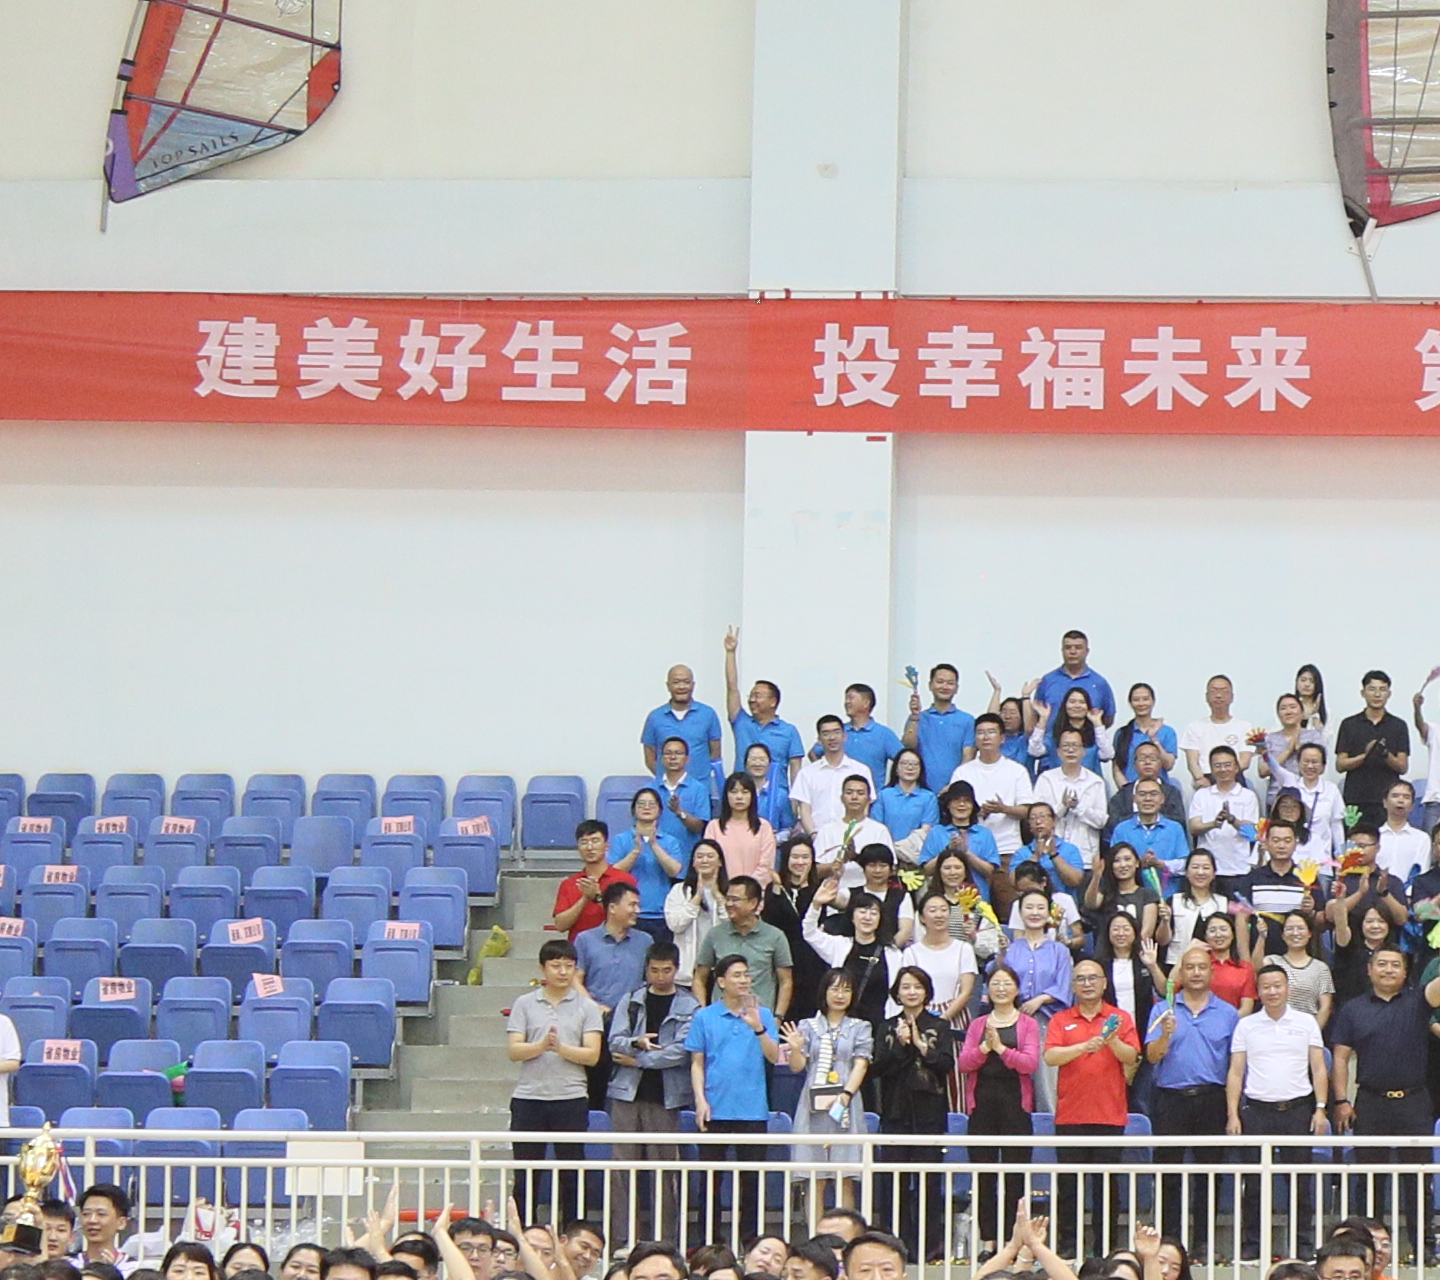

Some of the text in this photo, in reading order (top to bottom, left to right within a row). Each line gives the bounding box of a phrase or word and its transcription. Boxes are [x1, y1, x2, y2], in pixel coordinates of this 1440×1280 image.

[195, 315, 693, 407] 建美好生活
[812, 321, 1314, 413] 投幸福未来
